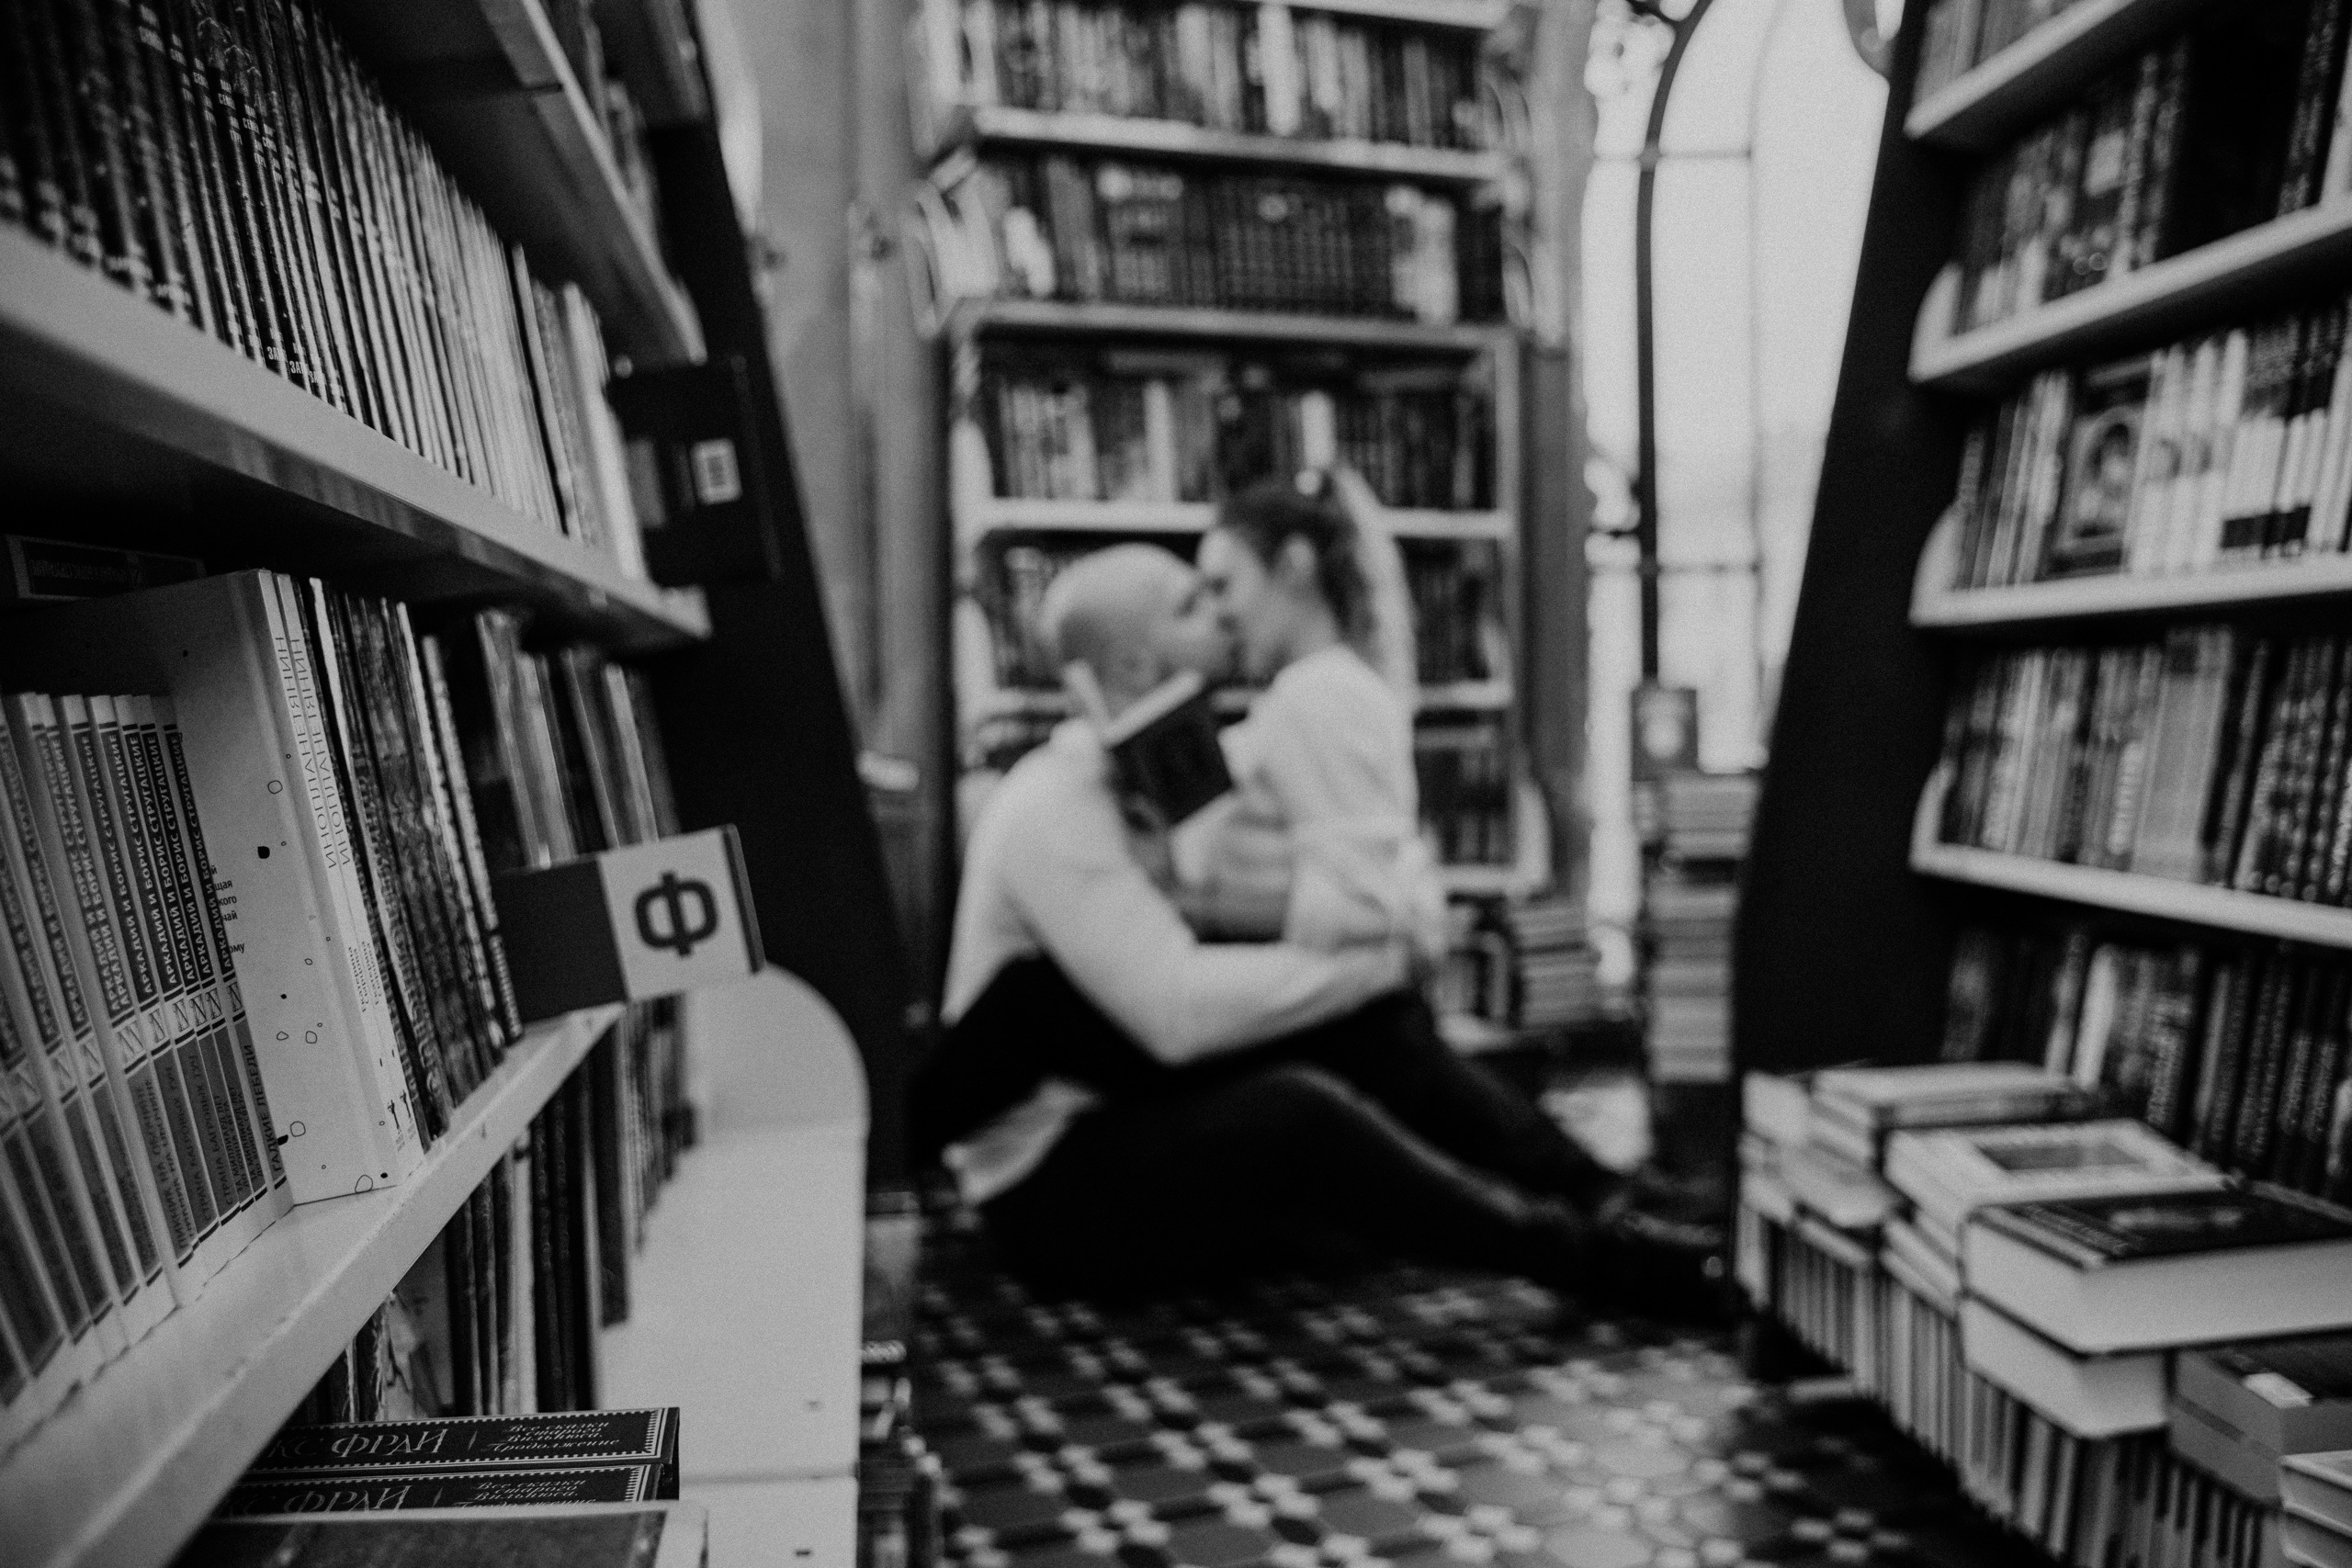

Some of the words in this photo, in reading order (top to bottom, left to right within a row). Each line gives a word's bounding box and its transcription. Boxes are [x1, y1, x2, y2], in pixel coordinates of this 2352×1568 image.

[107, 734, 141, 834] СТРУГАЦКИЕ
[128, 736, 161, 833] СТРУГАЦКИЕ
[145, 735, 177, 830] СТРУГАЦКИЕ
[275, 637, 337, 869] ИНОПЛАНЕТЯНИН
[291, 638, 351, 866] ИНОПЛАНЕТЯНИН
[80, 734, 115, 838] СТРУГАЦКИЕ
[80, 849, 104, 905] БОРИС
[107, 840, 129, 896] БОРИС
[133, 836, 154, 889] БОРИС
[153, 835, 174, 888] БОРИС
[169, 832, 190, 884] БОРИС
[192, 829, 212, 879] БОРИС
[151, 908, 178, 985] АРКАДИЙ
[170, 906, 197, 981] АРКАДИЙ
[186, 901, 212, 975] АРКАДИЙ
[209, 897, 233, 967] АРКАДИЙ
[636, 873, 717, 955] Ф
[100, 924, 130, 1006] АРКАДИЙ
[126, 914, 154, 994] АРКАДИЙ
[188, 1054, 202, 1078] ТУЧ
[243, 1043, 266, 1107] ЛЕБЕДИ
[260, 1111, 284, 1172] ГАДКИЕ
[215, 1156, 234, 1205] СТРАНА
[485, 1439, 620, 1453] Продолжение
[546, 1422, 609, 1430] сказки
[477, 1482, 511, 1490] Все
[517, 1479, 586, 1487] сказки
